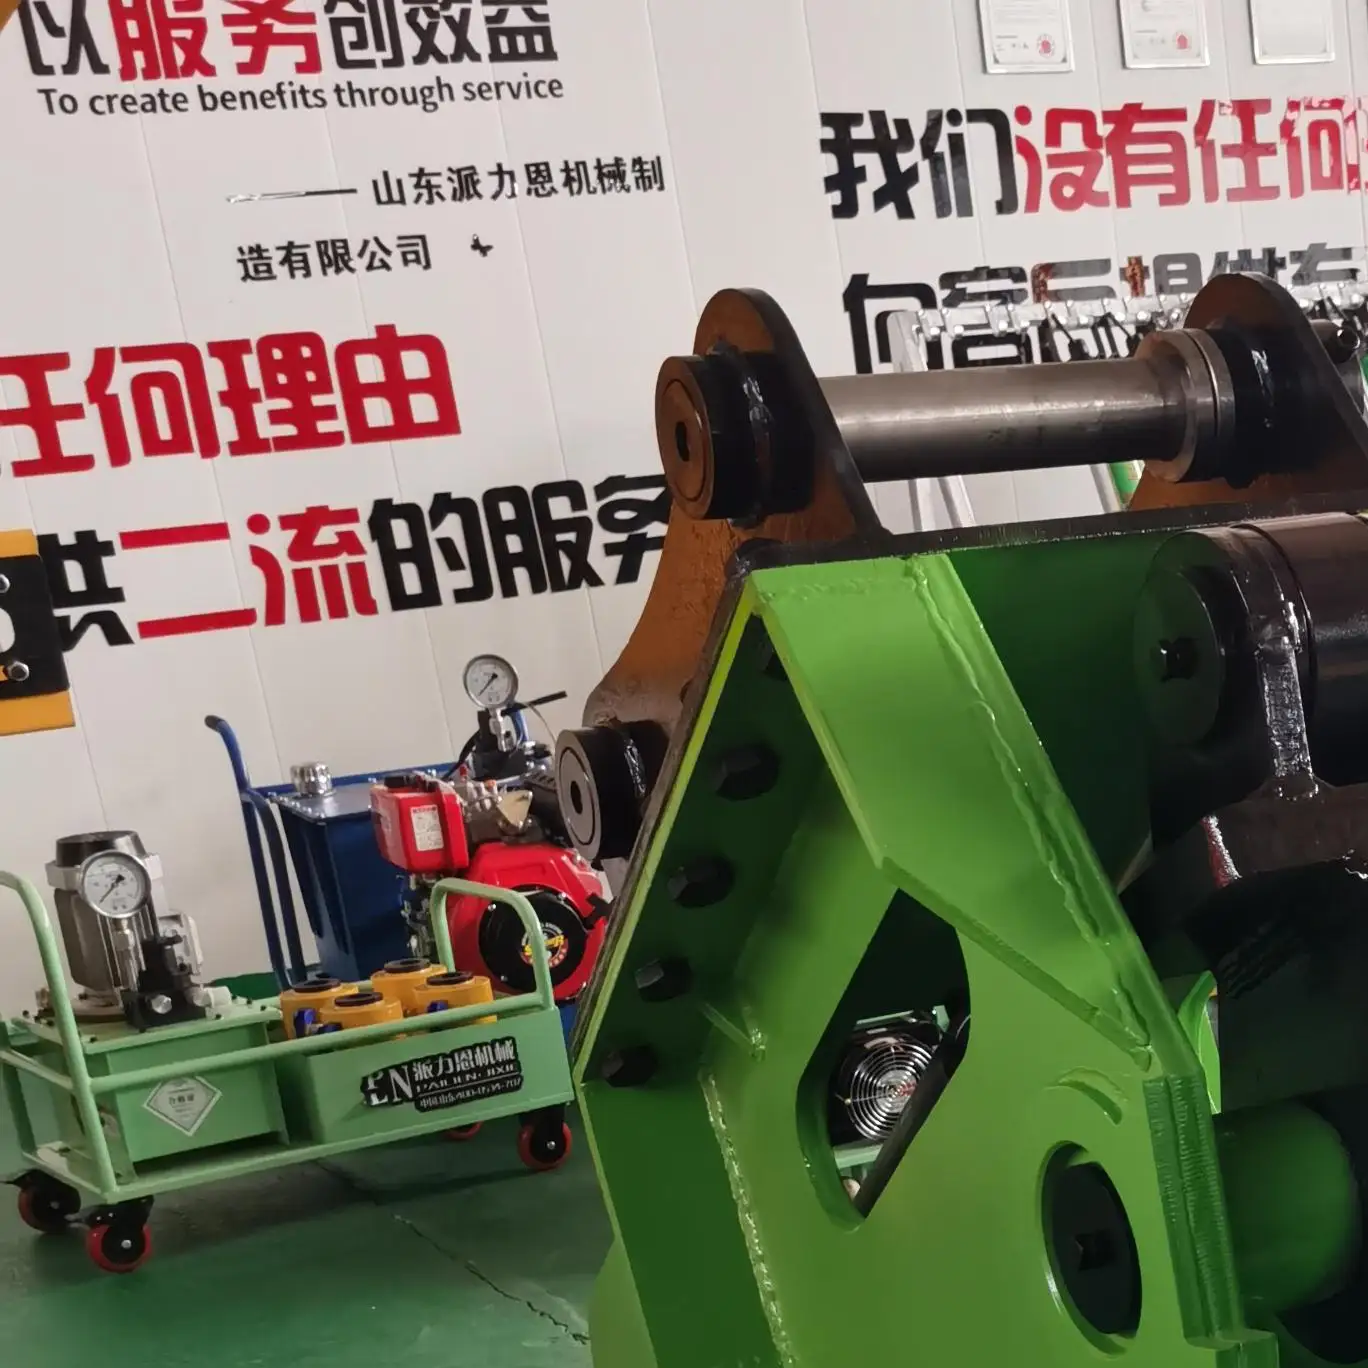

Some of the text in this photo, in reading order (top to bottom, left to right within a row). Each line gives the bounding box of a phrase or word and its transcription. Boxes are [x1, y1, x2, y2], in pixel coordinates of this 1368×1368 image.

[37, 71, 564, 116] To create benefits through service
[237, 234, 433, 282] 造有限公司
[412, 1039, 516, 1081] 派力恩机械
